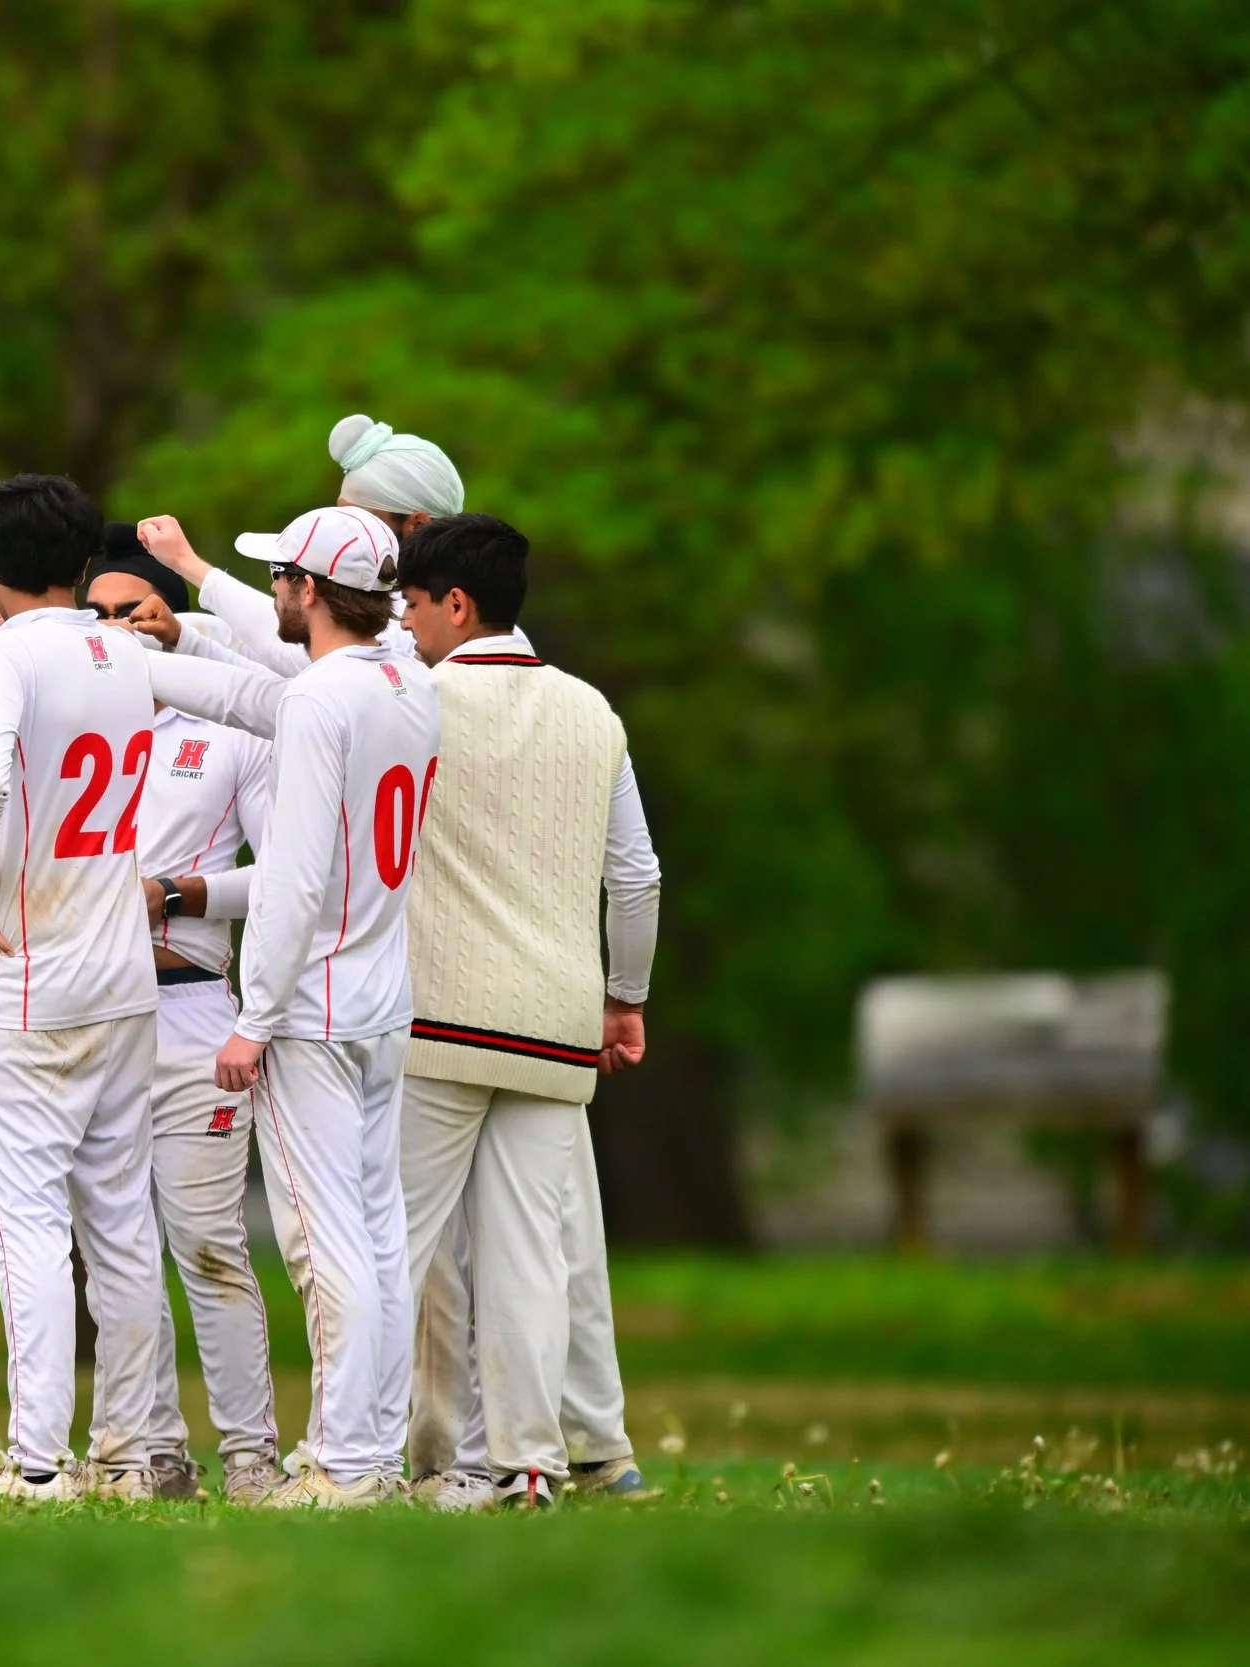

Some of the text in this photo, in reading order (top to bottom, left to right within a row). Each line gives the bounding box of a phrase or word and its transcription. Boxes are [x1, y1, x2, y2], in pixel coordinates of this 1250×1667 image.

[172, 739, 210, 770] H
[170, 769, 205, 780] CRICKET
[54, 729, 154, 859] 22
[208, 1105, 238, 1132] H
